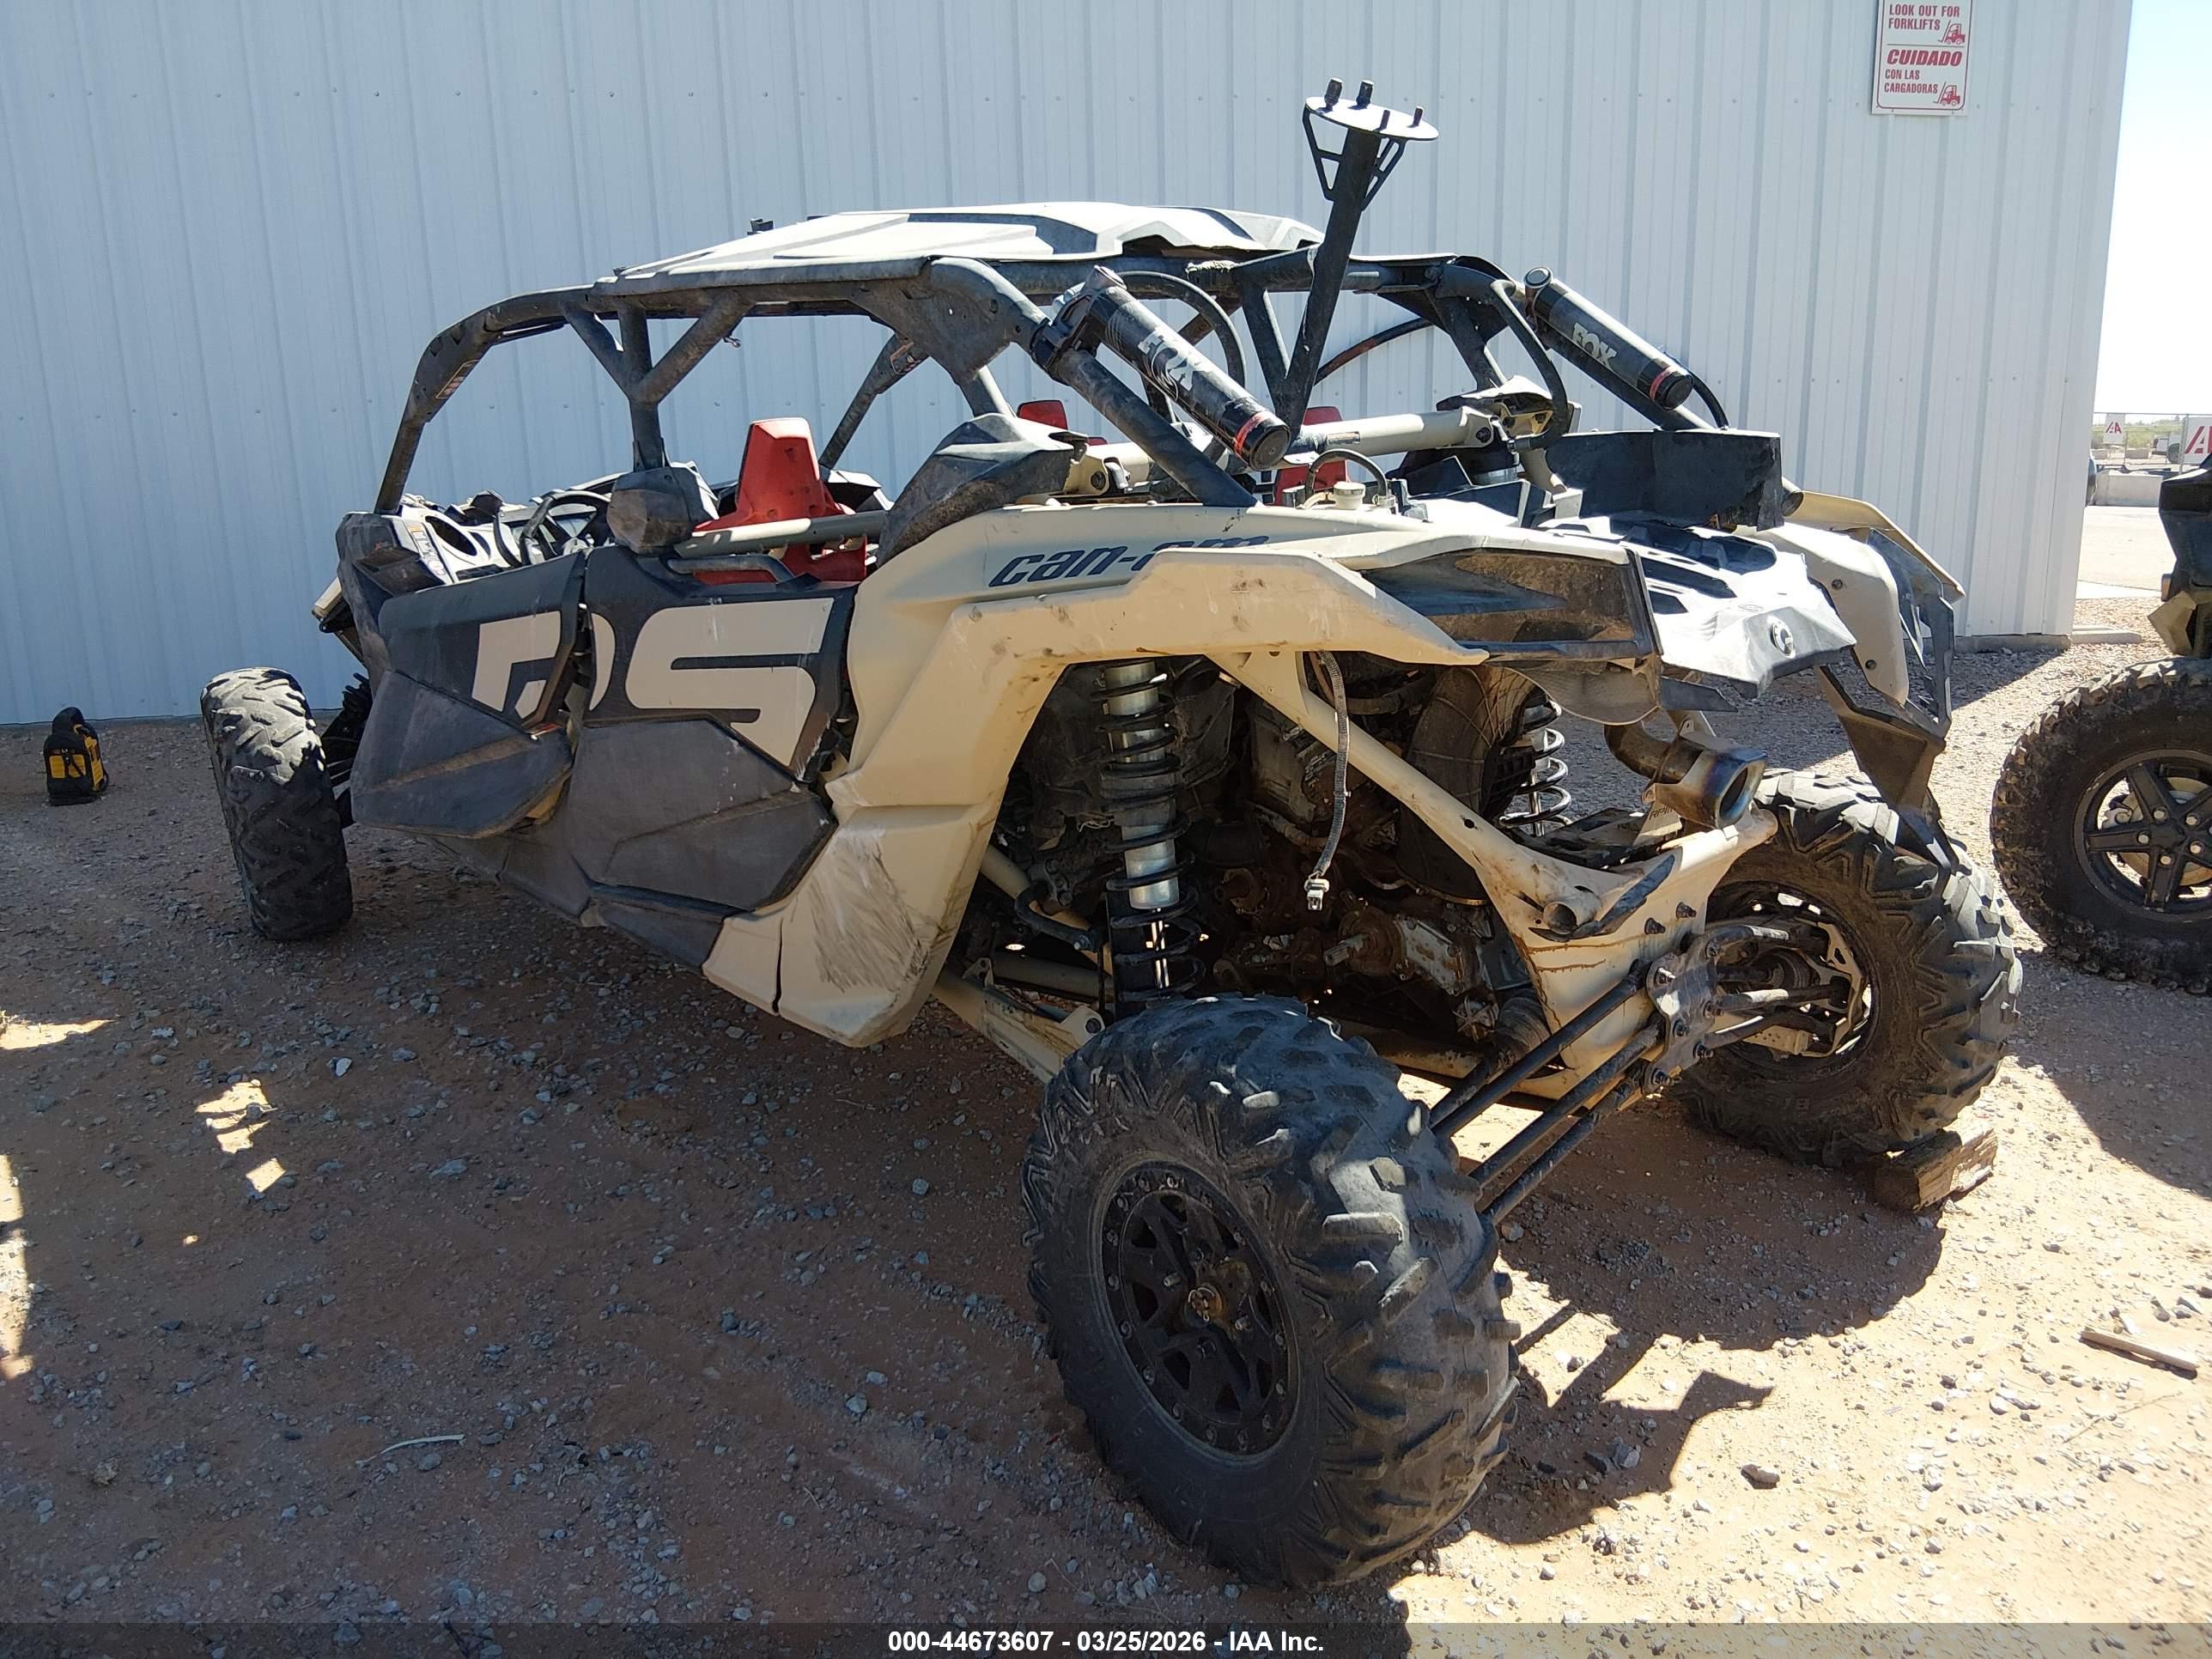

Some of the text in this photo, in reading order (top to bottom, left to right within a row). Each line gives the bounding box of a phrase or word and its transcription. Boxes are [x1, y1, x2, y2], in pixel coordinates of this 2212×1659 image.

[1889, 4, 1960, 17] LOOK OUT FOR
[1888, 18, 1941, 31] FORKLIFTS
[1887, 49, 1962, 66] CUIDADO
[1885, 69, 1920, 80] CON LAS
[1884, 82, 1938, 94] CARGADORAS
[1572, 322, 1617, 368] FOX
[1138, 325, 1208, 395] FOX
